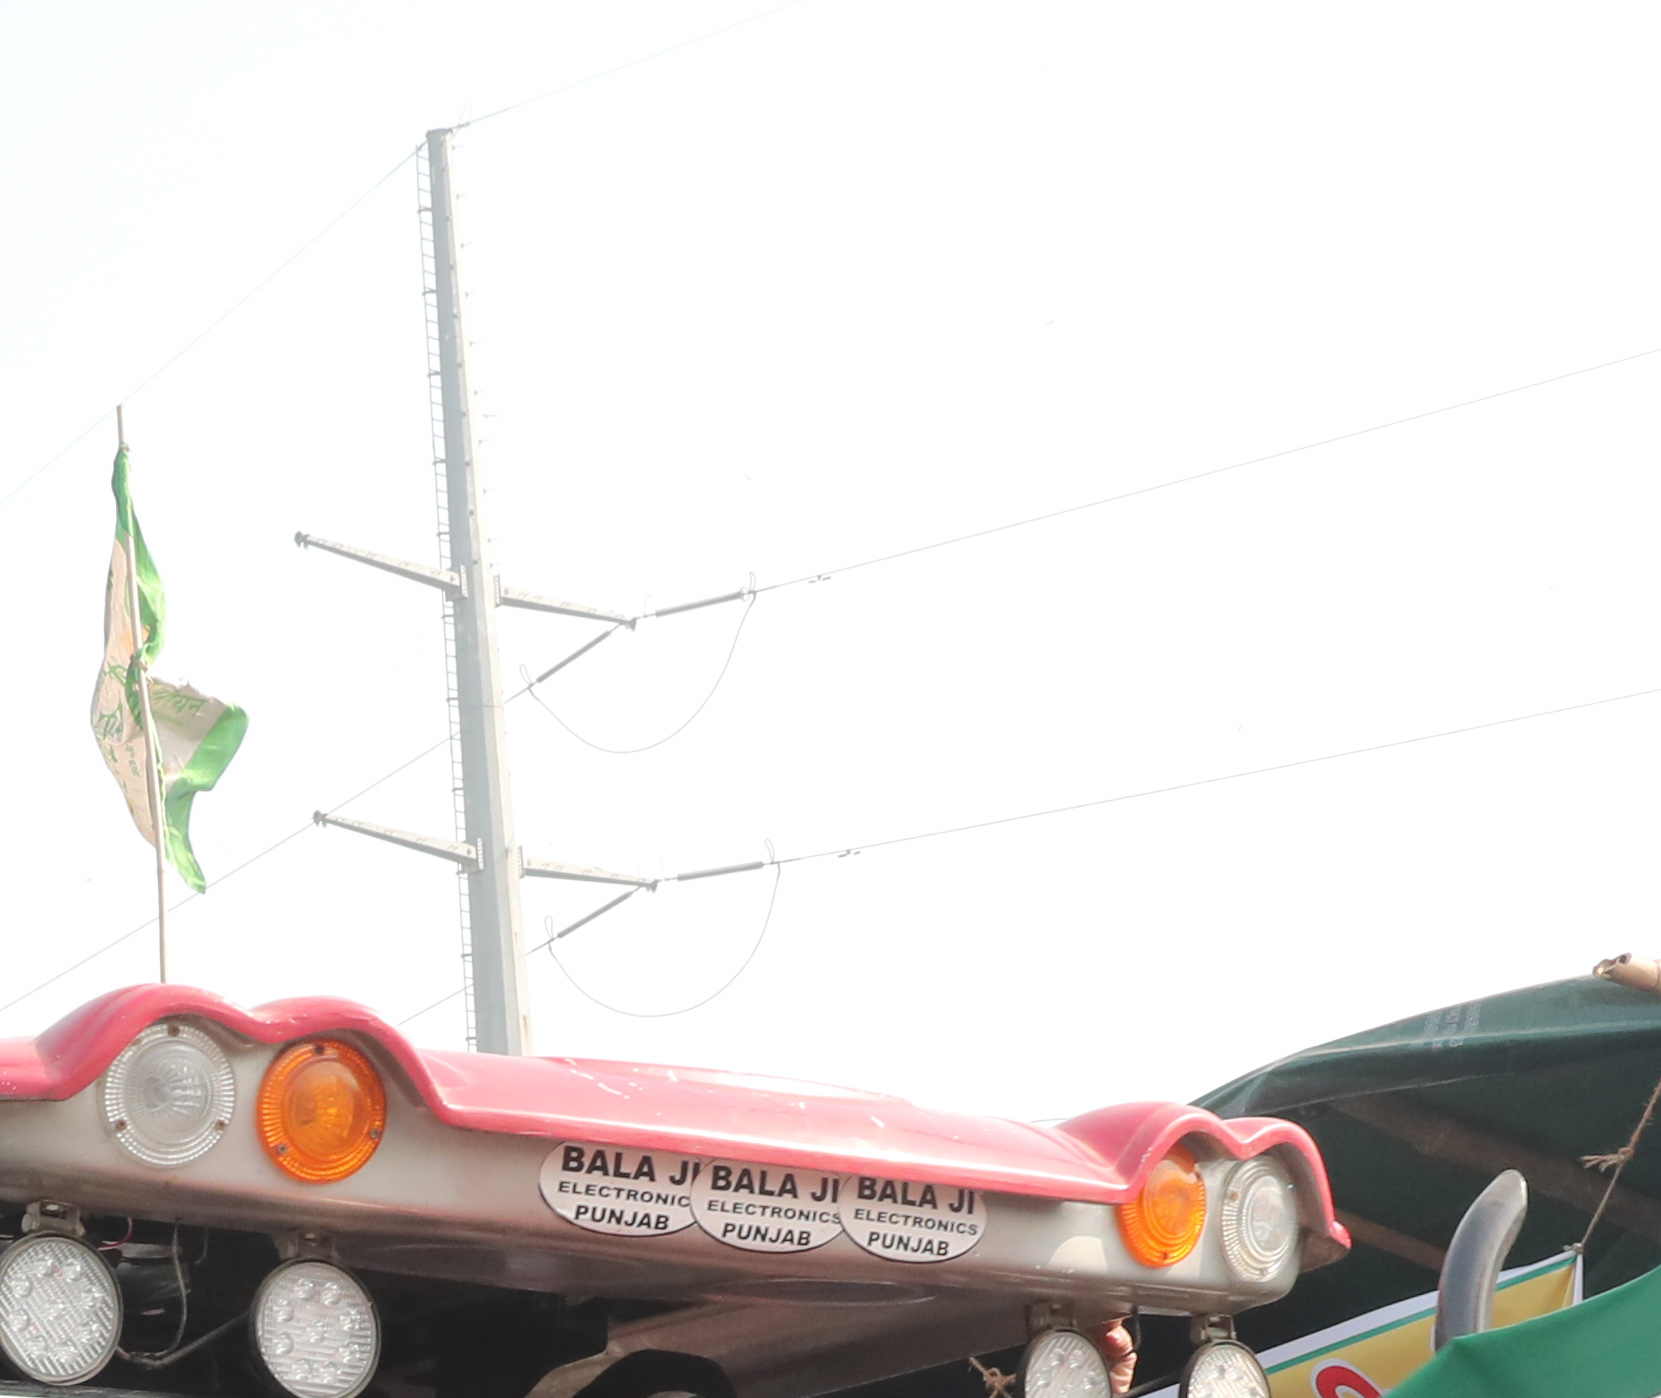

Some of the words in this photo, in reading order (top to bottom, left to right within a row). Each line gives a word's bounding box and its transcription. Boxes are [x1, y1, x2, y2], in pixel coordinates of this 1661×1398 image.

[561, 1146, 658, 1184] BALA
[557, 1180, 690, 1210] ELECTRONIC
[711, 1165, 797, 1200] BALA
[810, 1177, 839, 1204] JI
[857, 1177, 935, 1209] BALA
[947, 1187, 976, 1215] JI
[574, 1204, 670, 1231] PUNJAB
[707, 1199, 842, 1226] ELECTRONICS
[853, 1207, 979, 1237] ELECTRONICS
[721, 1222, 812, 1248] PUNJAB
[867, 1231, 950, 1258] PUNJAB
